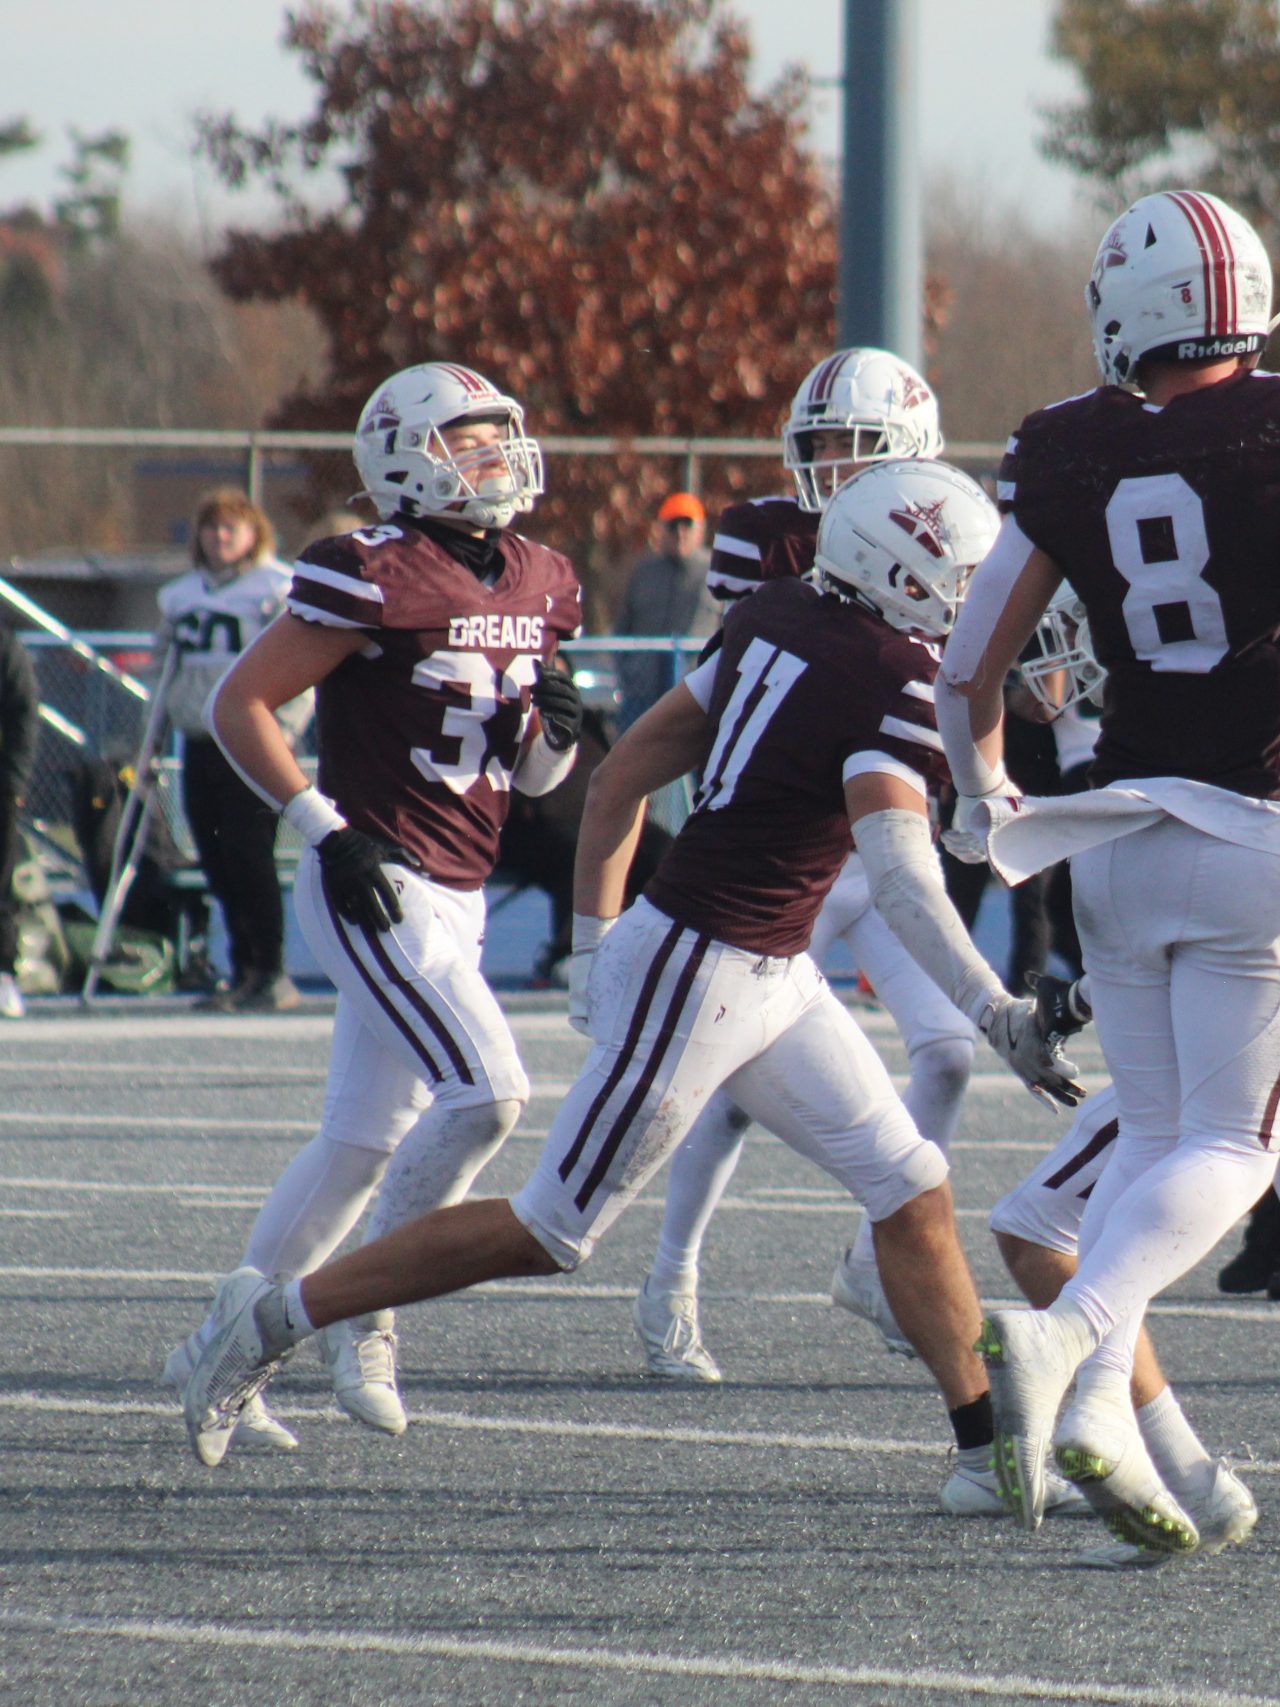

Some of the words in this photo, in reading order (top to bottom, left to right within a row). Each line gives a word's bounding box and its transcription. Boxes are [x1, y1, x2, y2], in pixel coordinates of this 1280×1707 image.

[448, 614, 544, 650] DREADS
[1105, 472, 1230, 674] 8
[694, 636, 809, 812] 11
